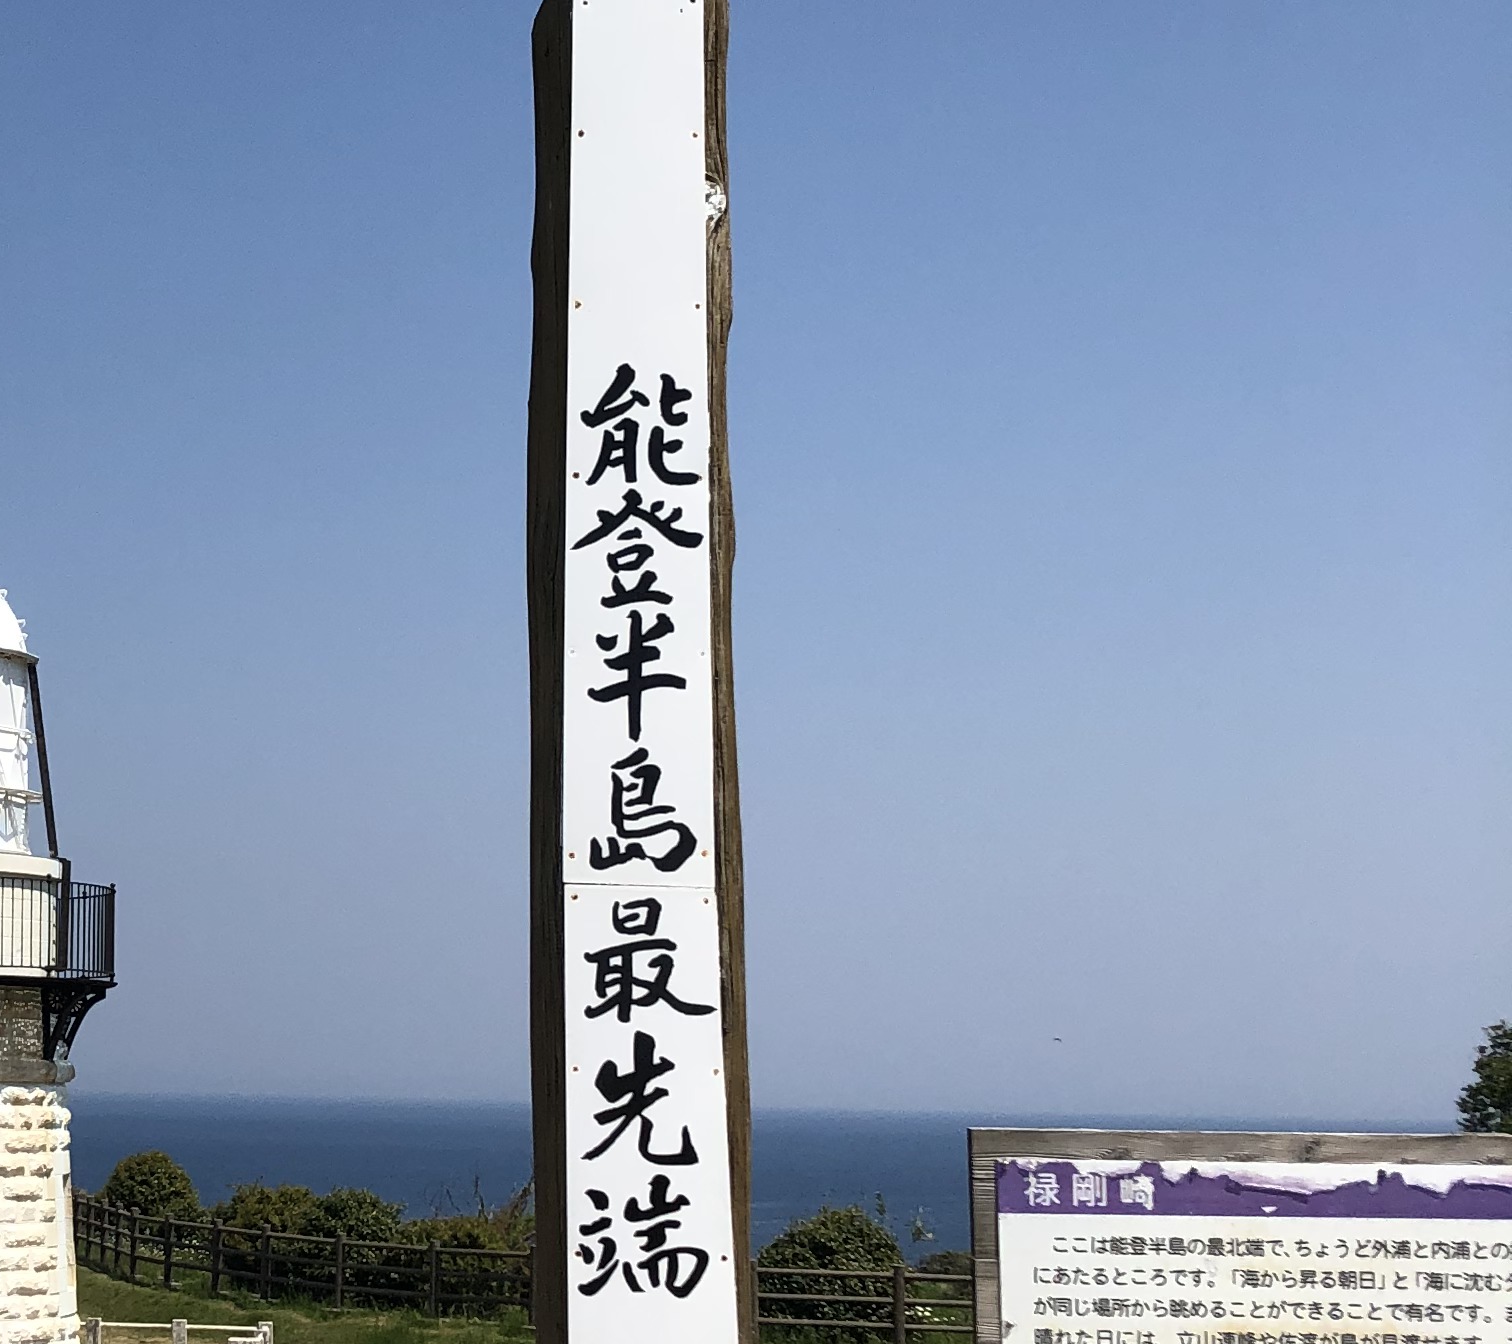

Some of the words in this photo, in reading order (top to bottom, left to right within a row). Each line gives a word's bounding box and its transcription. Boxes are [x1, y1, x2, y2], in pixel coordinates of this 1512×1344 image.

[569, 362, 718, 1299] 能登半島最先端
[1023, 1171, 1155, 1210] 禄剛崎
[1052, 1235, 1512, 1260] ここは能登半島の最北端で、ちょうど外浦と内浦との
